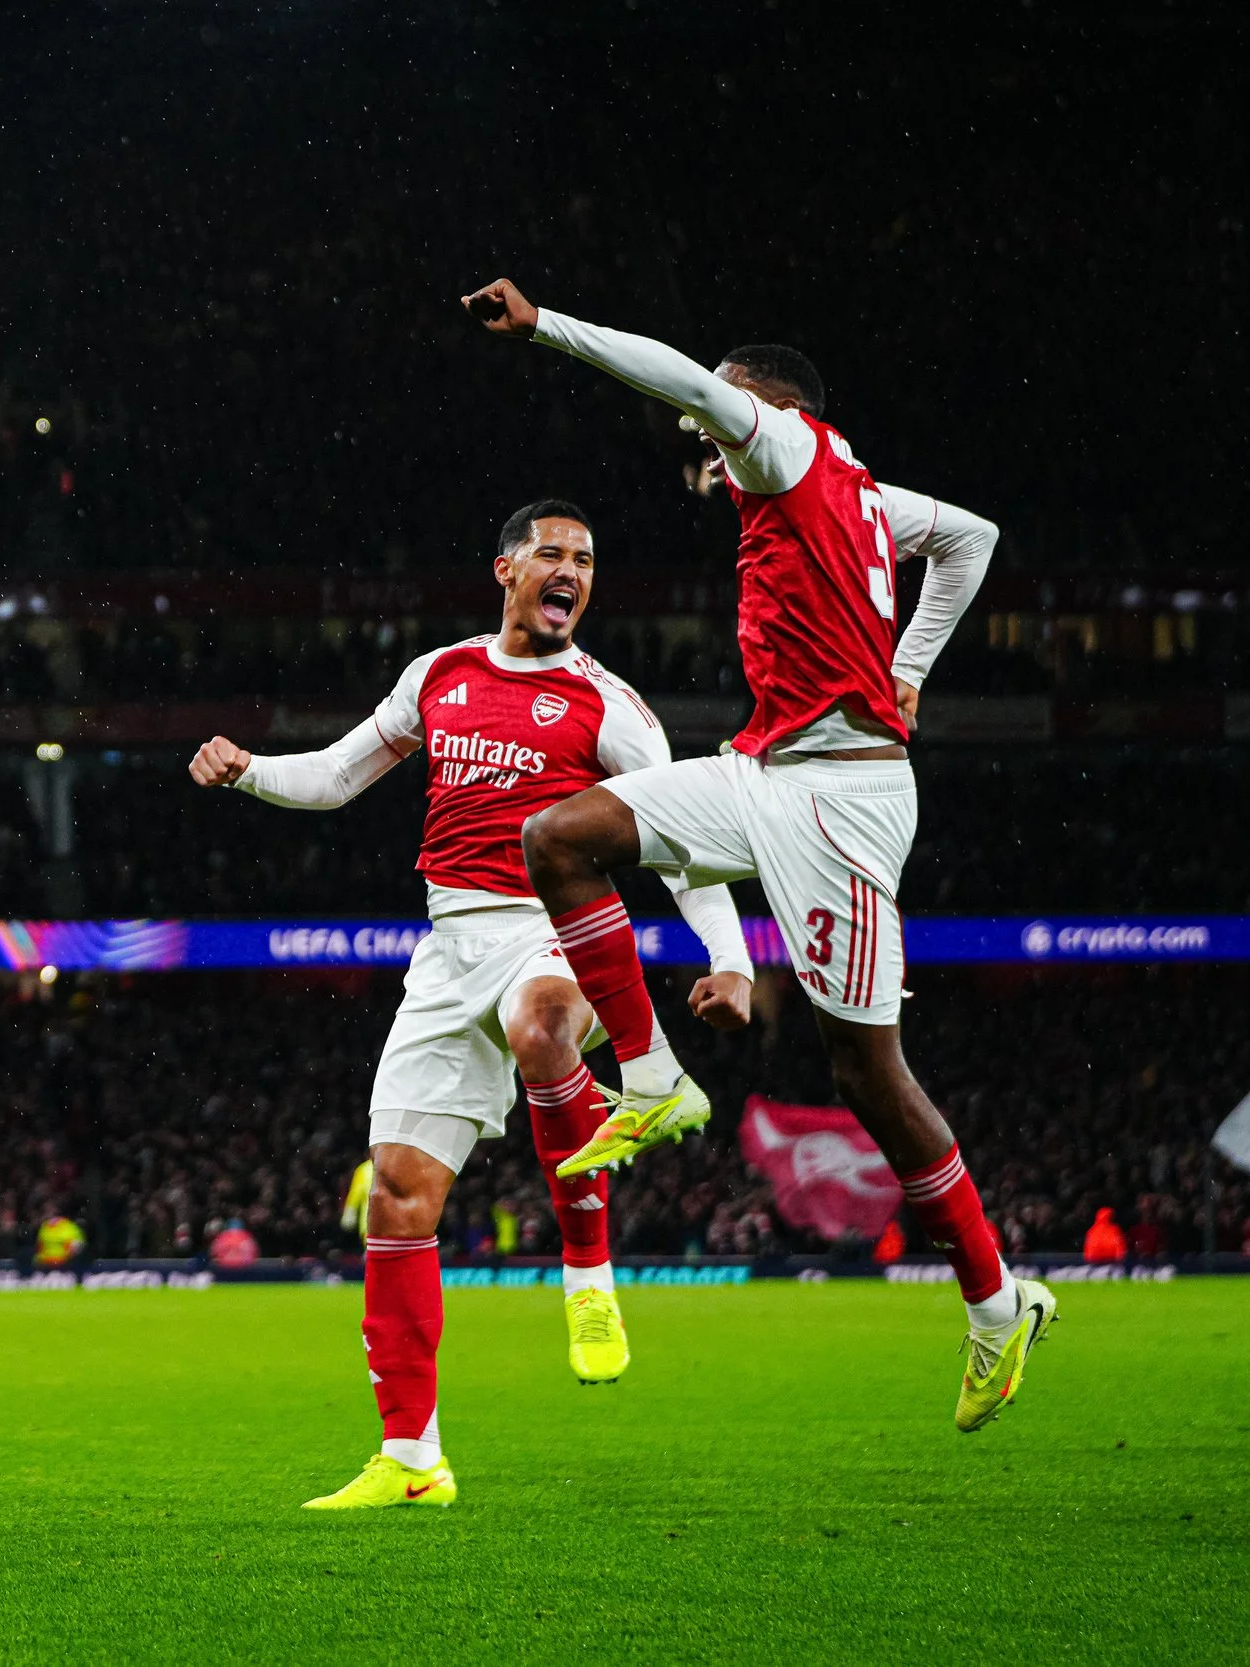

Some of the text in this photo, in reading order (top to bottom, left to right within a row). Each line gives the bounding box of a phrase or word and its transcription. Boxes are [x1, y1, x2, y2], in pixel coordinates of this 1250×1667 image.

[431, 729, 547, 774] Emirates
[441, 761, 464, 786] FLY
[269, 928, 350, 961] UEFA
[805, 907, 835, 967] 3
[1057, 923, 1210, 957] crypto.com
